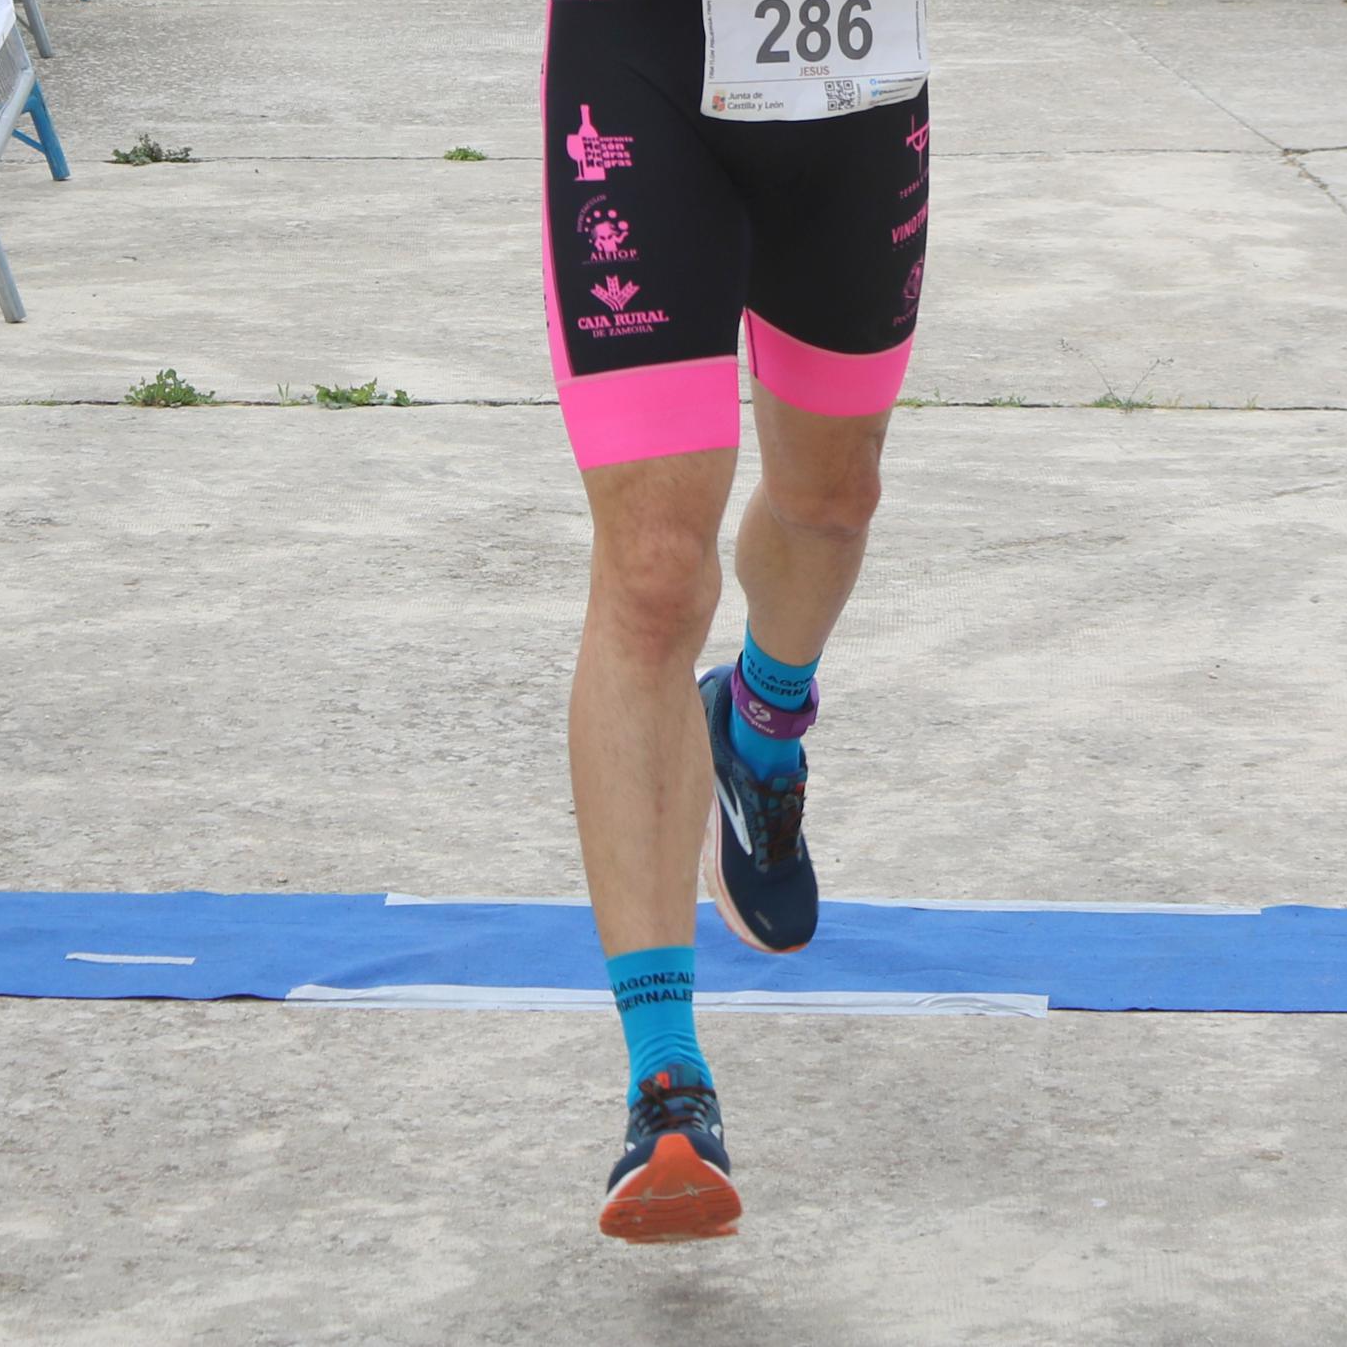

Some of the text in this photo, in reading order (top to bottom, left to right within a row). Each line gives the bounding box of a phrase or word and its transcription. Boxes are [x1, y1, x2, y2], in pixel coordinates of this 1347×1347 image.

[799, 65, 830, 77] JESUS
[728, 92, 751, 100] Junta
[727, 101, 784, 111] Castilla y León
[586, 159, 633, 169] Negras
[578, 310, 669, 331] CAJA RURAL
[592, 324, 654, 339] DE ZAMORA
